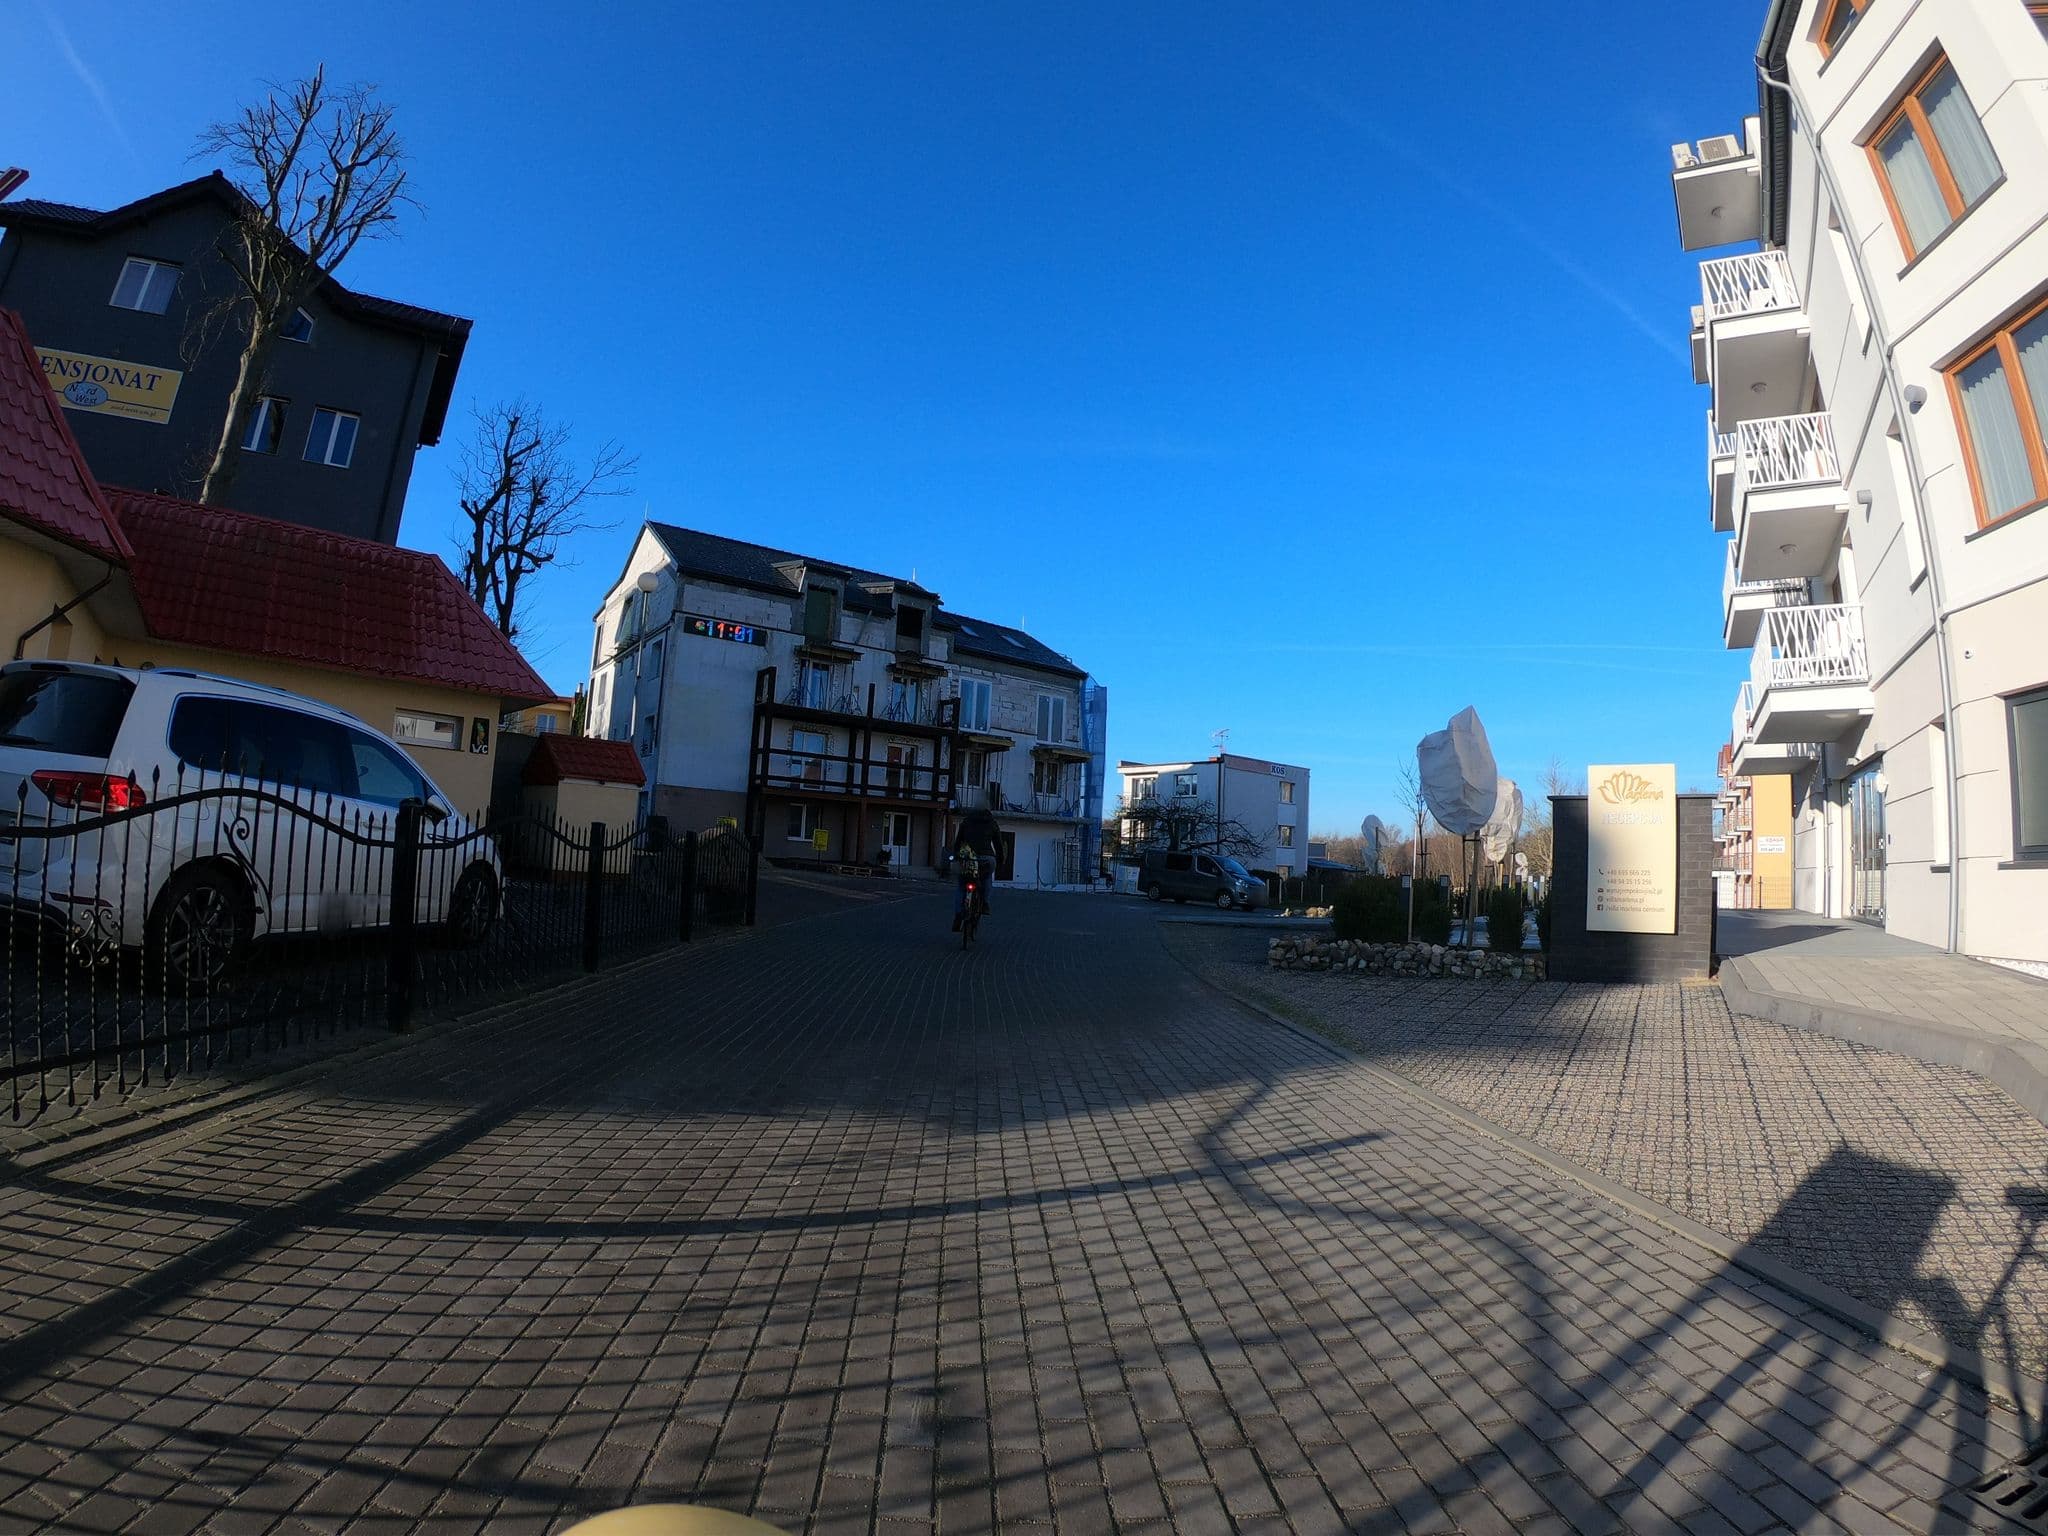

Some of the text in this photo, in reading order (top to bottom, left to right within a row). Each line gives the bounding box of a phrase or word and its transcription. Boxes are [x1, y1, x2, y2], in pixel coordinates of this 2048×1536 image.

[40, 355, 163, 392] ENSJONAT
[472, 743, 488, 754] WC
[1271, 765, 1285, 775] KOS
